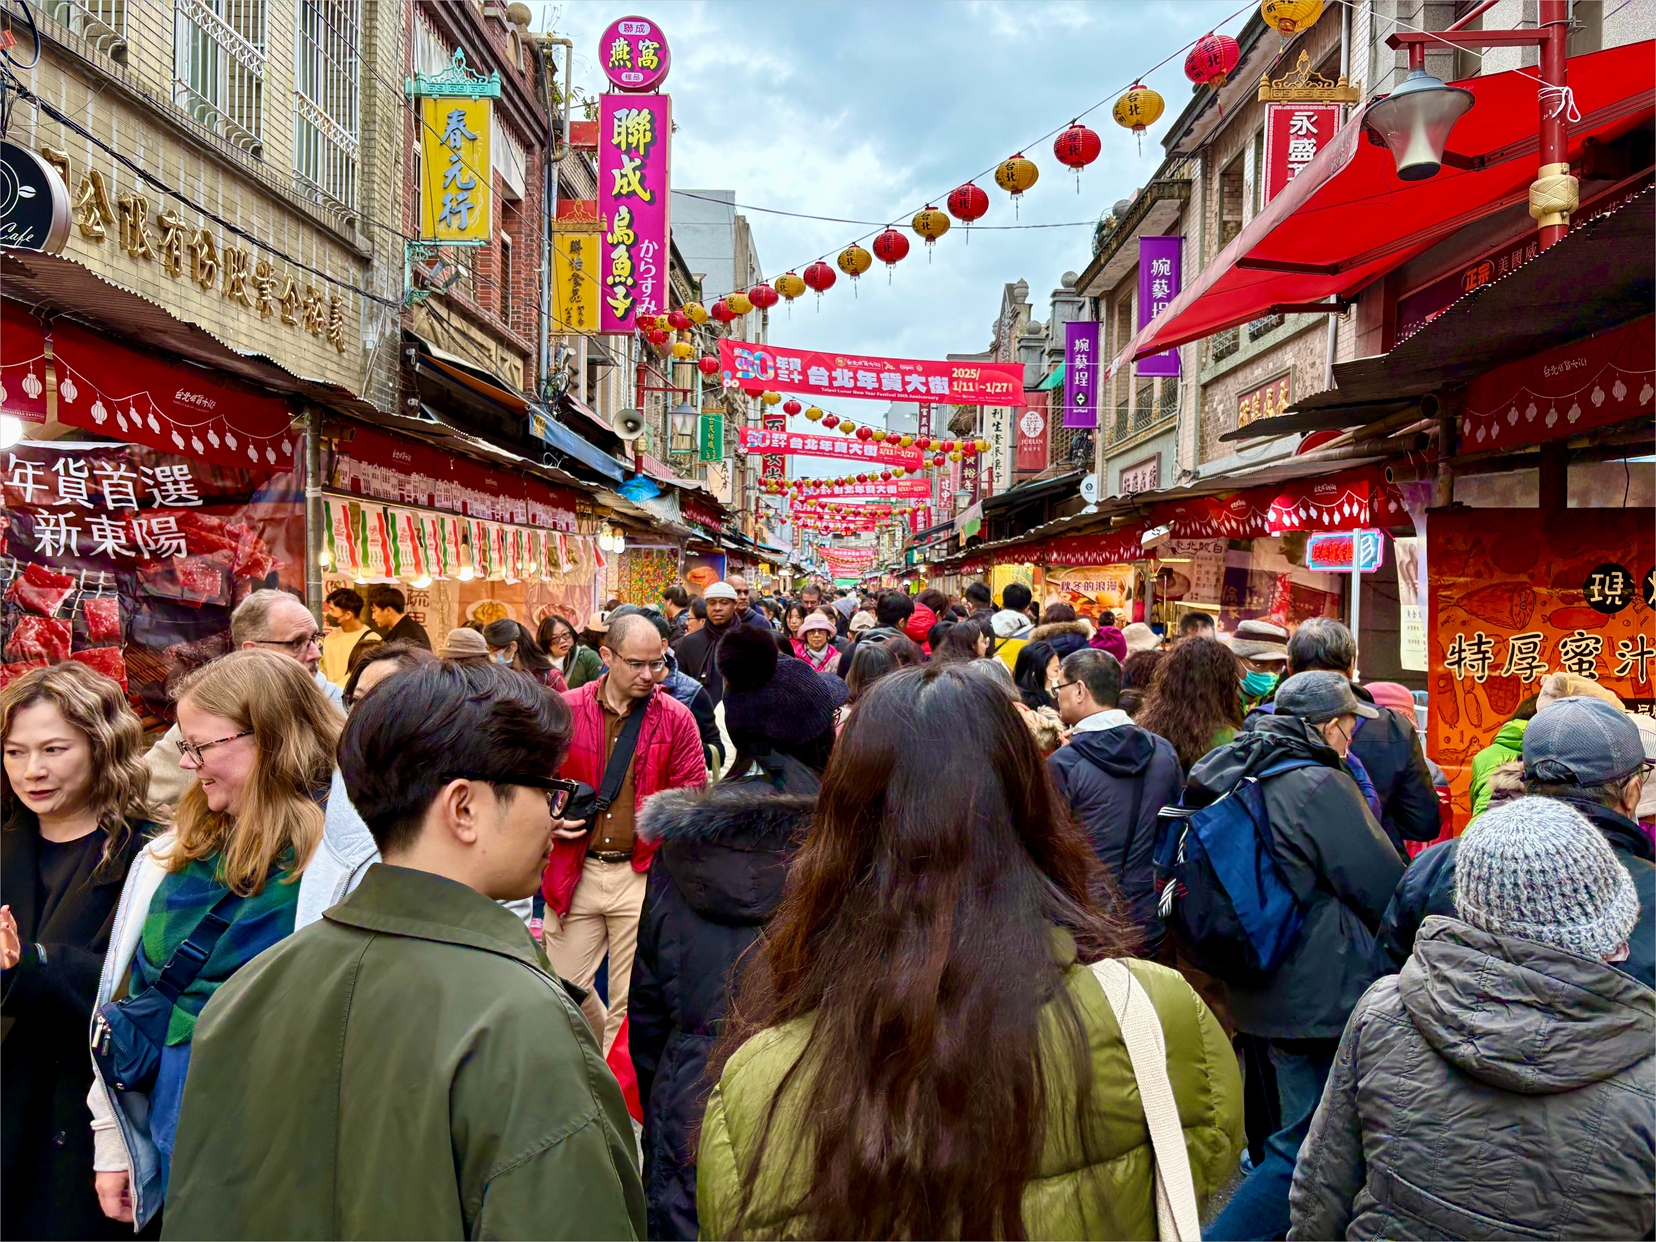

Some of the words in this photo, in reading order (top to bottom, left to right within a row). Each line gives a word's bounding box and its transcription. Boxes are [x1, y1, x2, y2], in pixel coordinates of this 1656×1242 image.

[623, 22, 645, 35] 聯成
[609, 37, 659, 71] 燕窩
[1127, 92, 1142, 116] 台北
[1067, 131, 1079, 156] 台北
[439, 107, 478, 231] 春元行
[1005, 161, 1017, 182] 台北
[958, 188, 969, 209] 台北
[606, 107, 653, 320] 聯成烏魚子
[921, 212, 931, 231] 台北
[638, 238, 660, 315] からすみ
[776, 355, 801, 371] 年貨
[952, 367, 981, 380] 2025/
[1073, 337, 1090, 386] 婉藝埕
[777, 371, 803, 384] 三十
[806, 365, 950, 395] 台北年貨大街
[790, 437, 878, 457] 台北年貨大街
[4, 452, 203, 512] 年貨首選
[34, 508, 189, 560] 新東陽
[1445, 629, 1656, 685] 特厚蜜汁
